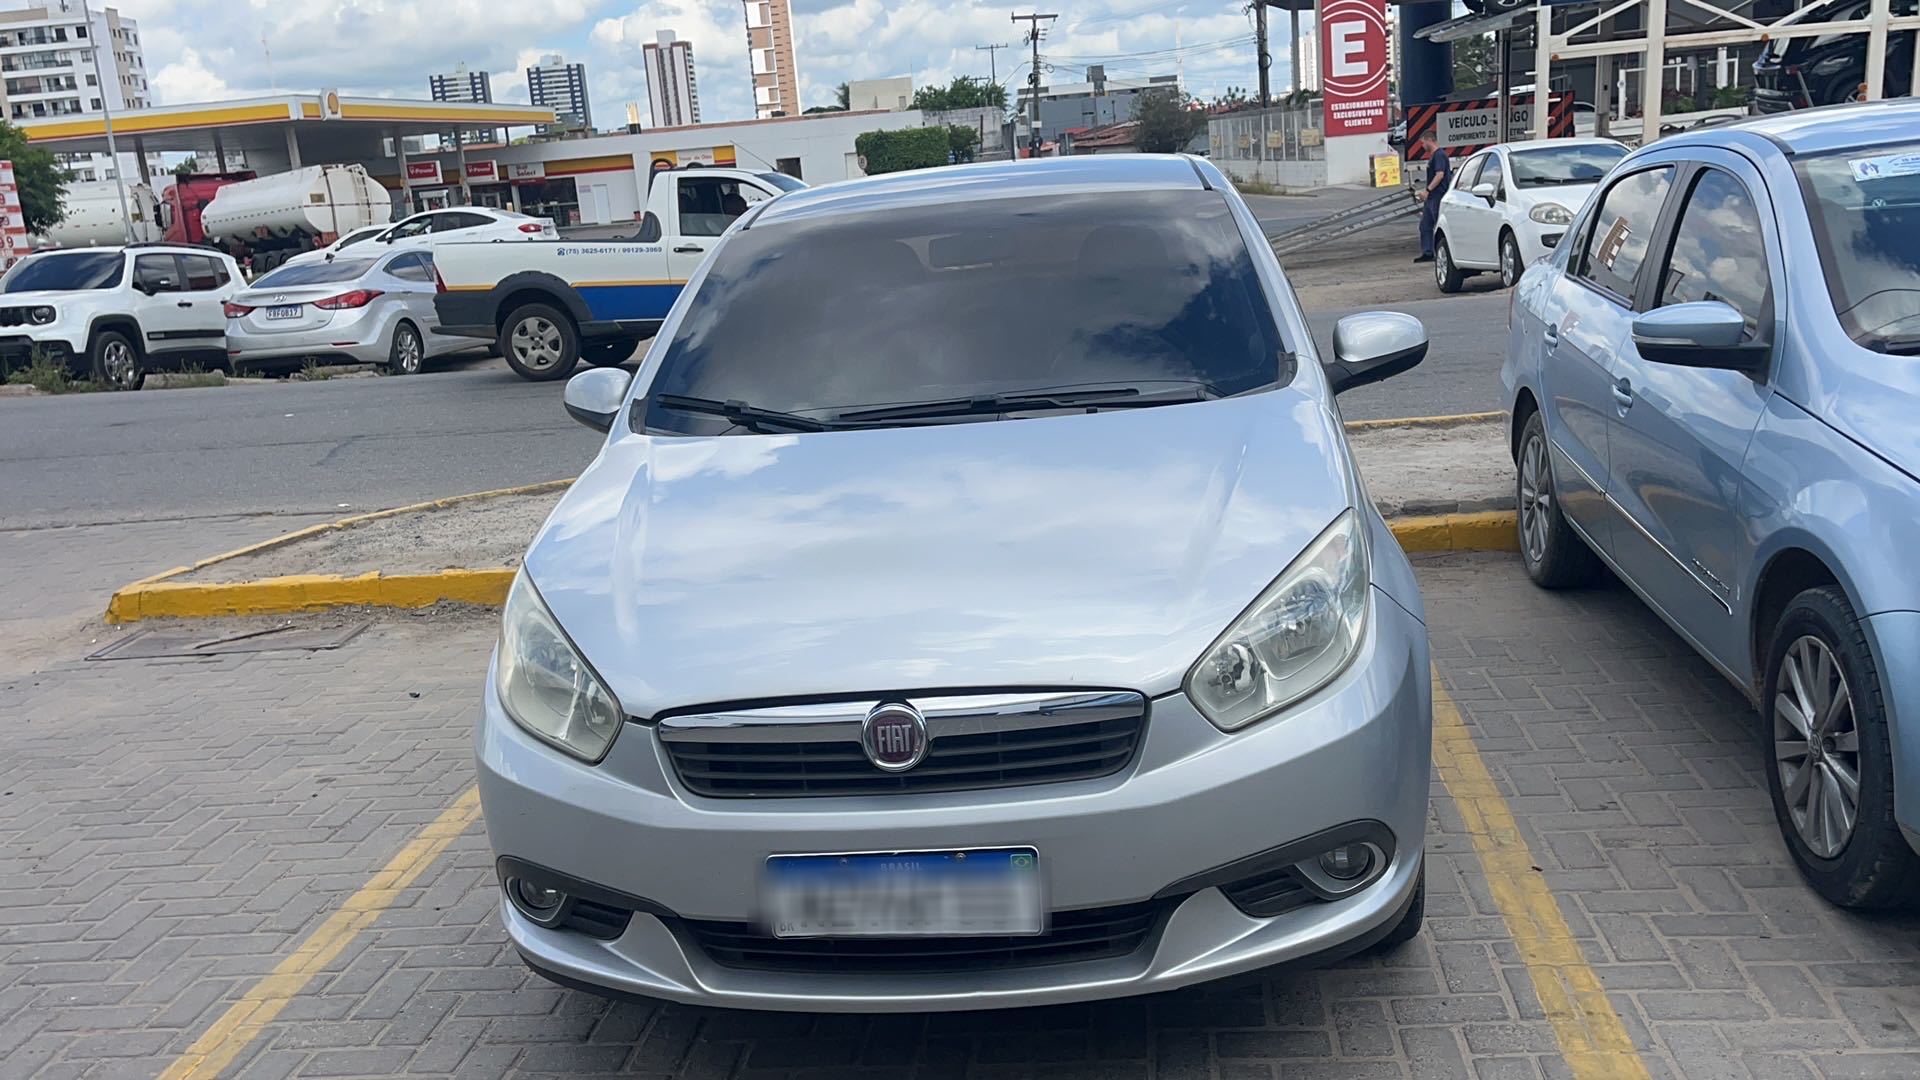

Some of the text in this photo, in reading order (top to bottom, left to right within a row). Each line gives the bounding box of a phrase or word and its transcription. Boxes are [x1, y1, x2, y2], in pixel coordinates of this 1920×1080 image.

[1330, 20, 1368, 77] E
[1331, 99, 1385, 111] ESTACIONAMENTO
[1333, 108, 1383, 119] EXCLUSIVO PARA
[1344, 118, 1373, 127] CLIENTES
[1448, 113, 1488, 129] VEÍCULO
[876, 724, 912, 754] FIAT
[880, 861, 922, 872] BRASIL
